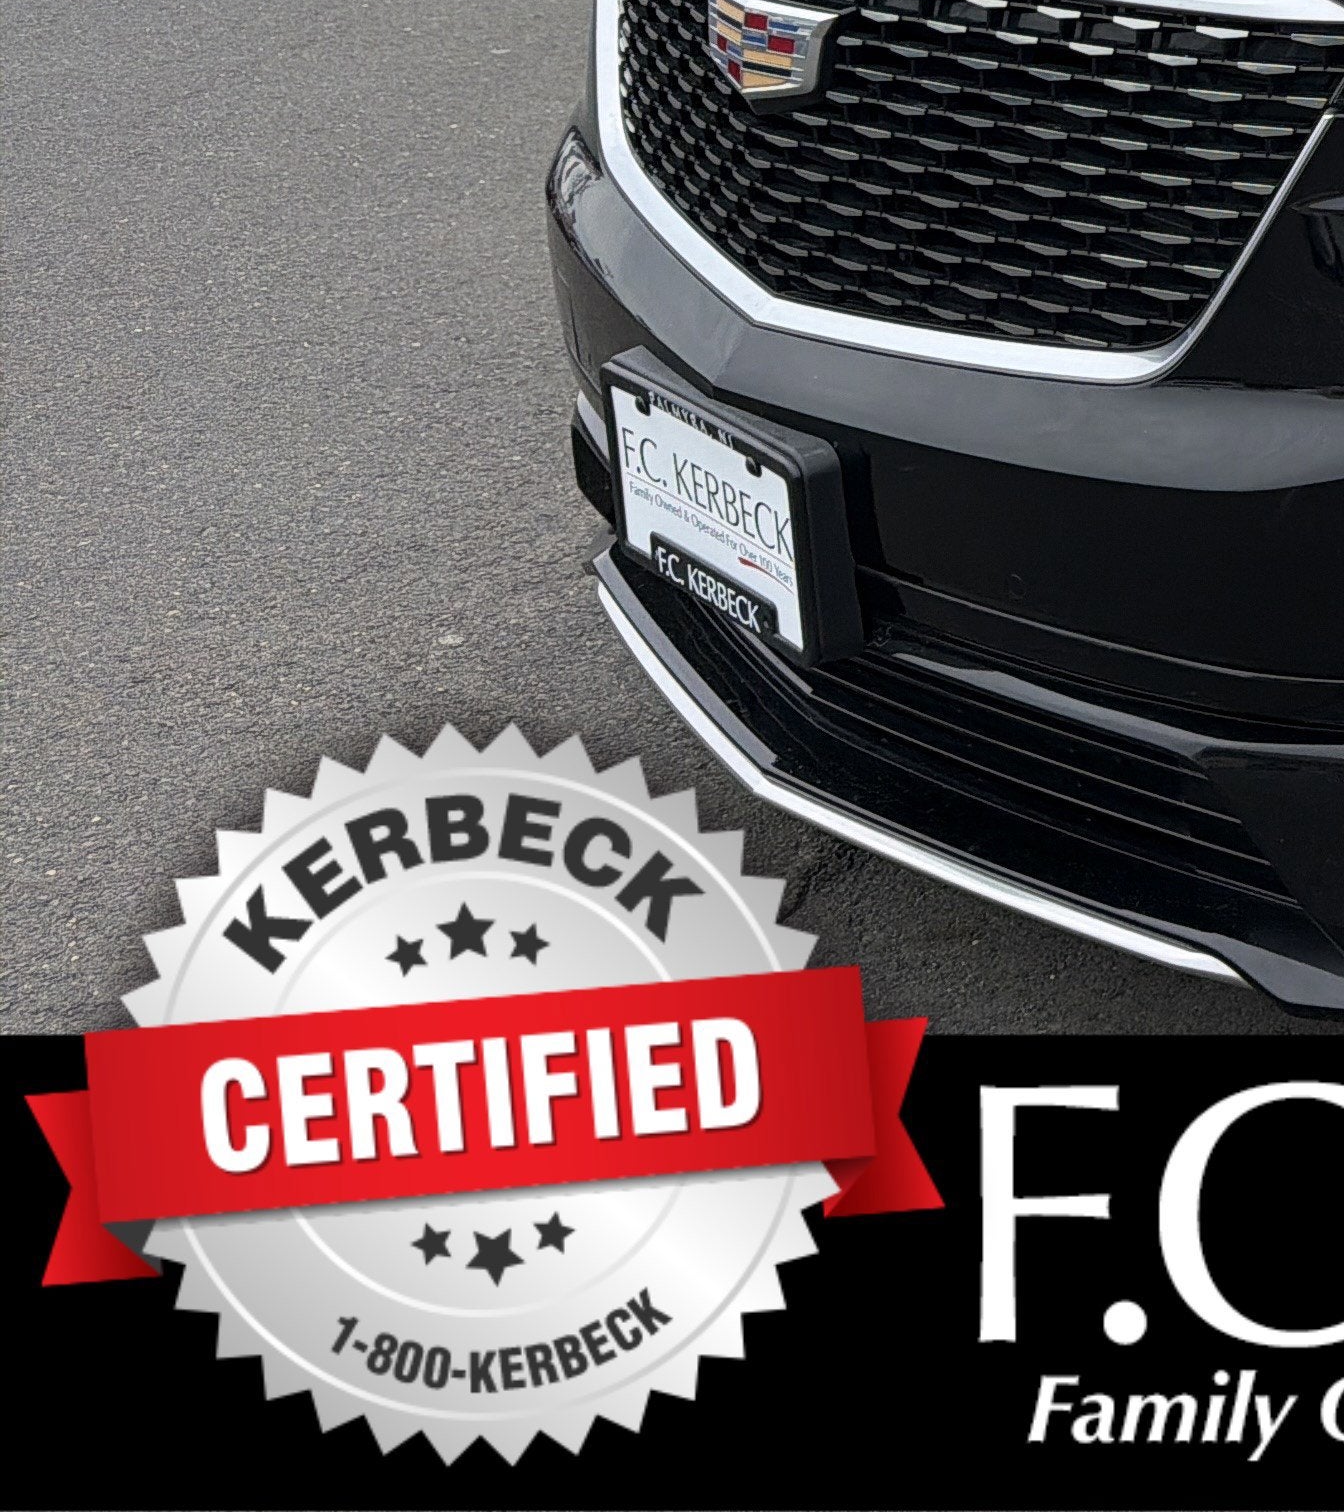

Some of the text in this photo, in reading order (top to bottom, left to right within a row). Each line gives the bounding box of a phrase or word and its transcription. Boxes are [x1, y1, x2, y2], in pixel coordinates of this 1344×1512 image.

[622, 426, 794, 562] F.C. KERBECK
[687, 563, 762, 634] KERBECK
